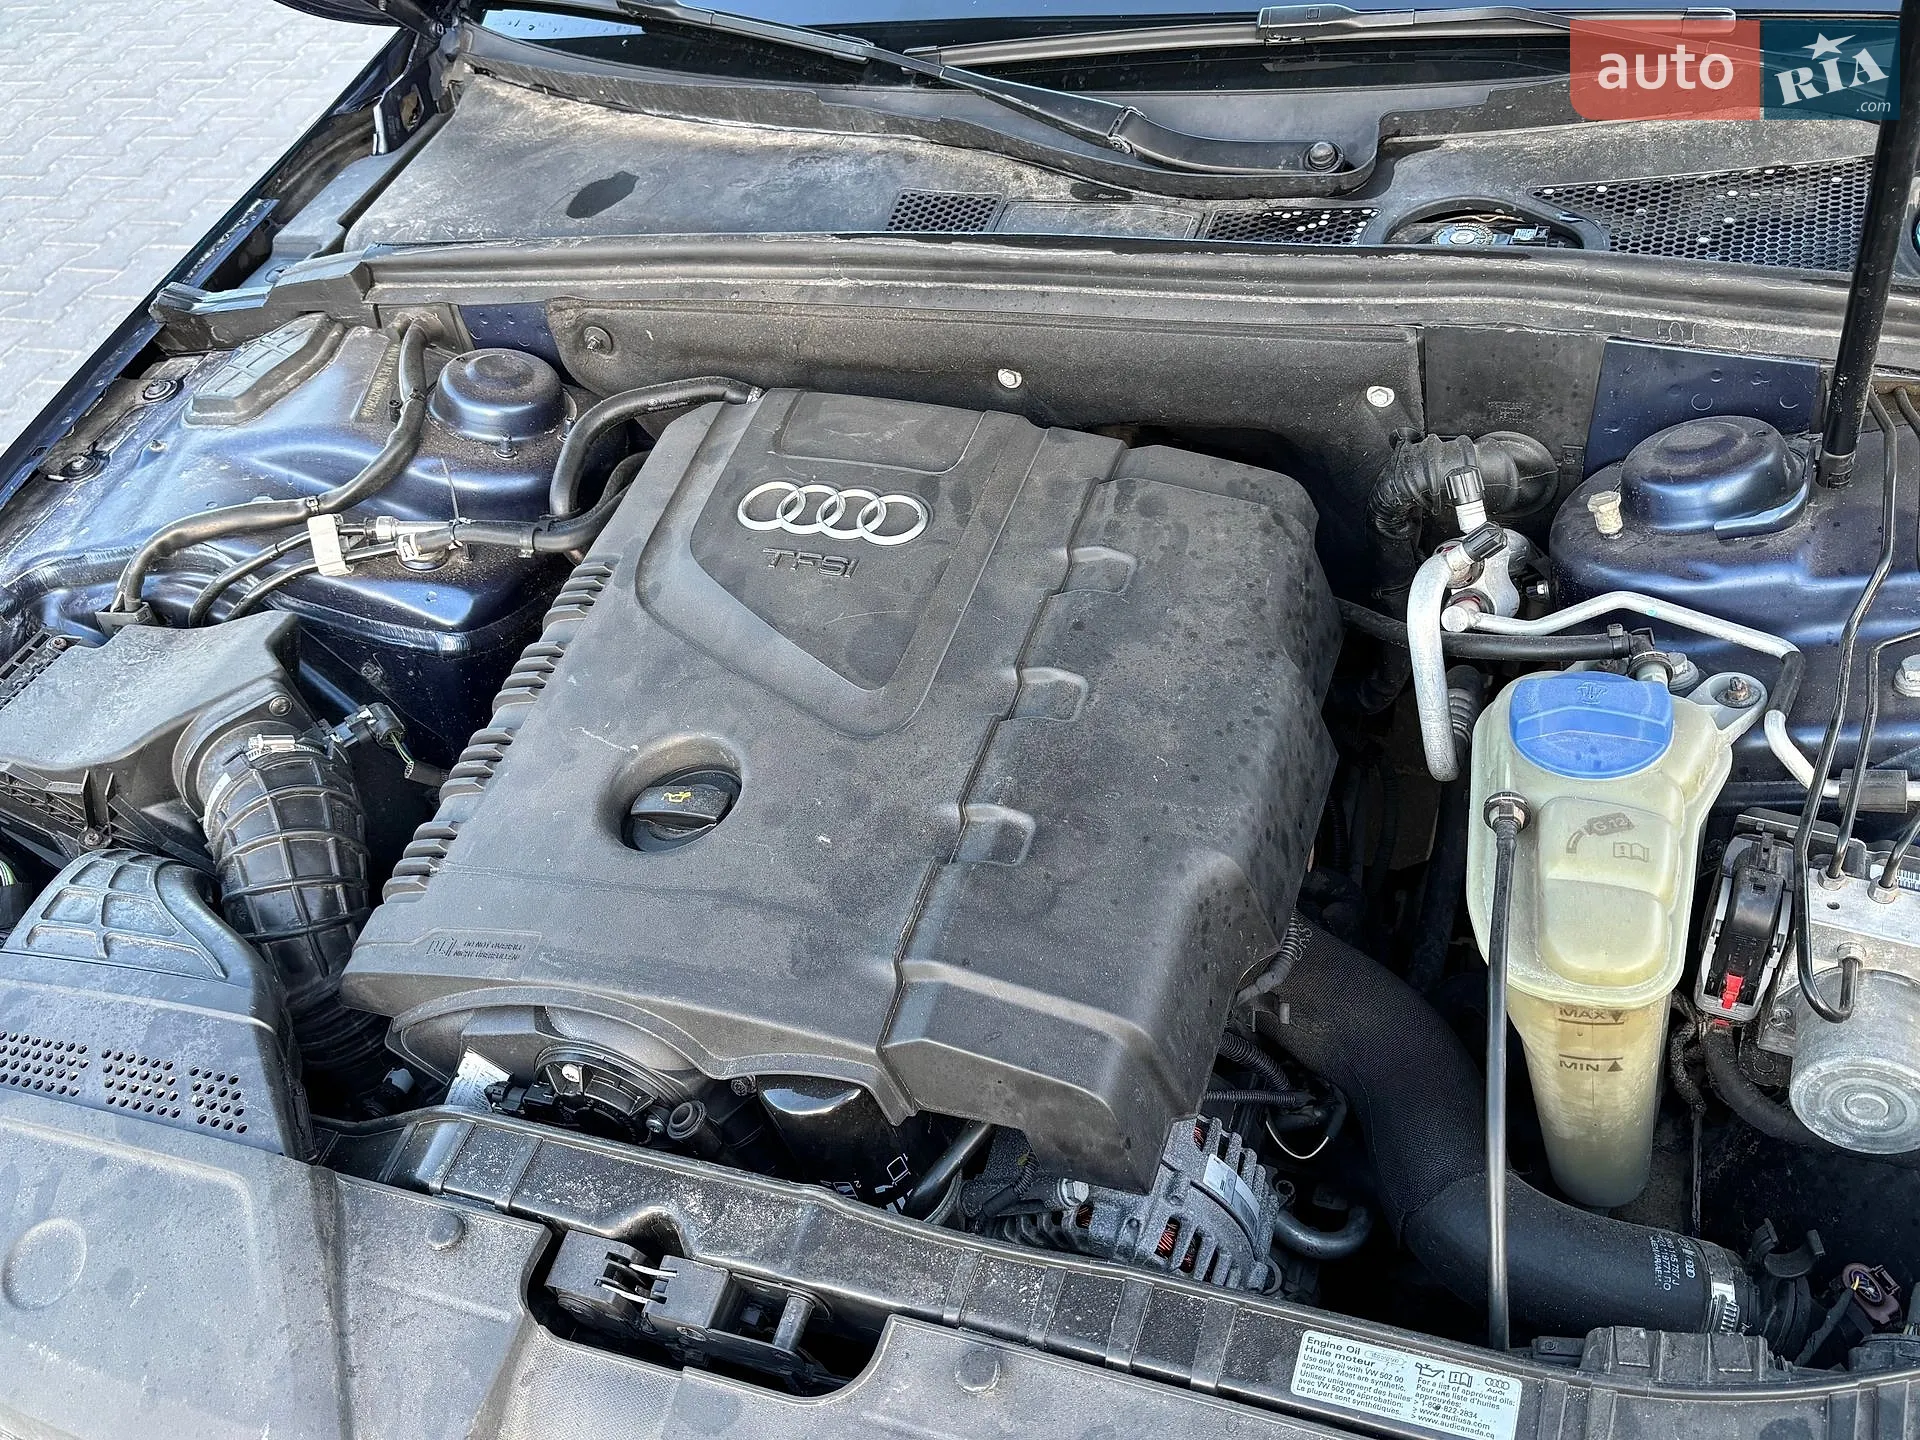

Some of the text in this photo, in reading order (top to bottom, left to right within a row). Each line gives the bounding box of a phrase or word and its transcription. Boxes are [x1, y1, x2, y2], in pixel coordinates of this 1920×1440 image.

[763, 547, 859, 578] TFSI
[1560, 1007, 1605, 1019] MAX
[1560, 1060, 1599, 1072] MIN
[1307, 1336, 1360, 1355] Engine Oil
[1305, 1345, 1331, 1357] Huile
[1335, 1353, 1375, 1367] moteur
[1304, 1354, 1317, 1362] Use
[1319, 1359, 1334, 1367] only
[1365, 1367, 1378, 1376] VW
[1380, 1372, 1393, 1380] 502
[1337, 1369, 1355, 1379] Most
[1299, 1378, 1314, 1386] avec
[1317, 1381, 1330, 1389] VW
[1332, 1385, 1344, 1393] 502
[1300, 1370, 1326, 1381] Utilisez
[1373, 1388, 1386, 1396] des
[1416, 1384, 1434, 1393] Pour
[1452, 1393, 1467, 1401] liste
[1418, 1377, 1430, 1385] For
[1439, 1382, 1450, 1390] list
[1461, 1389, 1497, 1401] approved
[1307, 1388, 1333, 1398] plupart
[1420, 1408, 1489, 1430] www.audiusa.com
